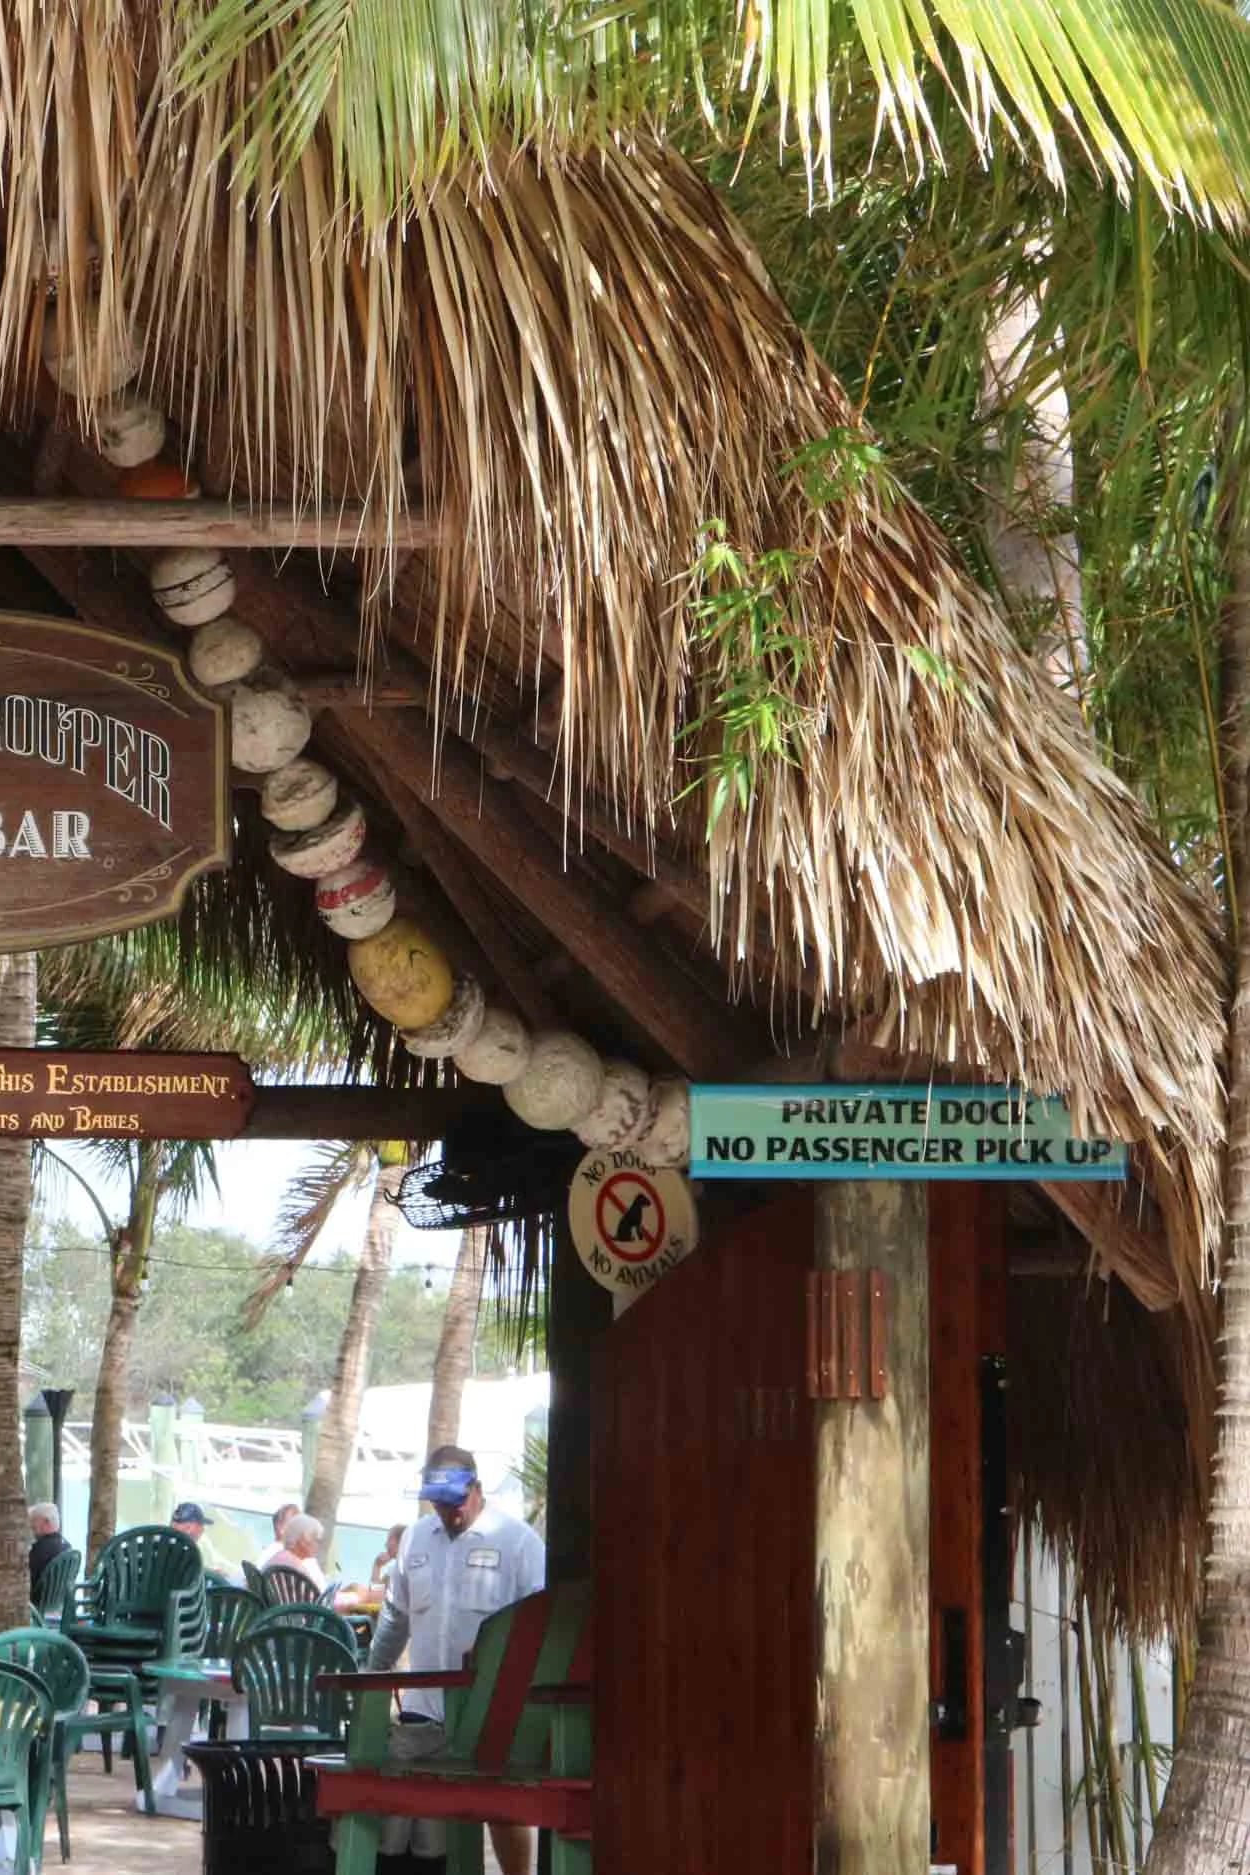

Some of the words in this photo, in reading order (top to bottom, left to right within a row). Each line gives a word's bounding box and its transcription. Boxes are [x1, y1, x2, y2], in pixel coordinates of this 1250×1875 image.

[781, 1099, 927, 1125] PRIVATE
[940, 1099, 1035, 1126] DOCK
[706, 1136, 755, 1161] NO
[766, 1136, 964, 1164] PASSENGER
[975, 1138, 1053, 1164] PICK
[1064, 1138, 1112, 1164] UP
[581, 1160, 606, 1186] NO
[590, 1244, 612, 1275] NO
[614, 1234, 685, 1288] ANIMALS
